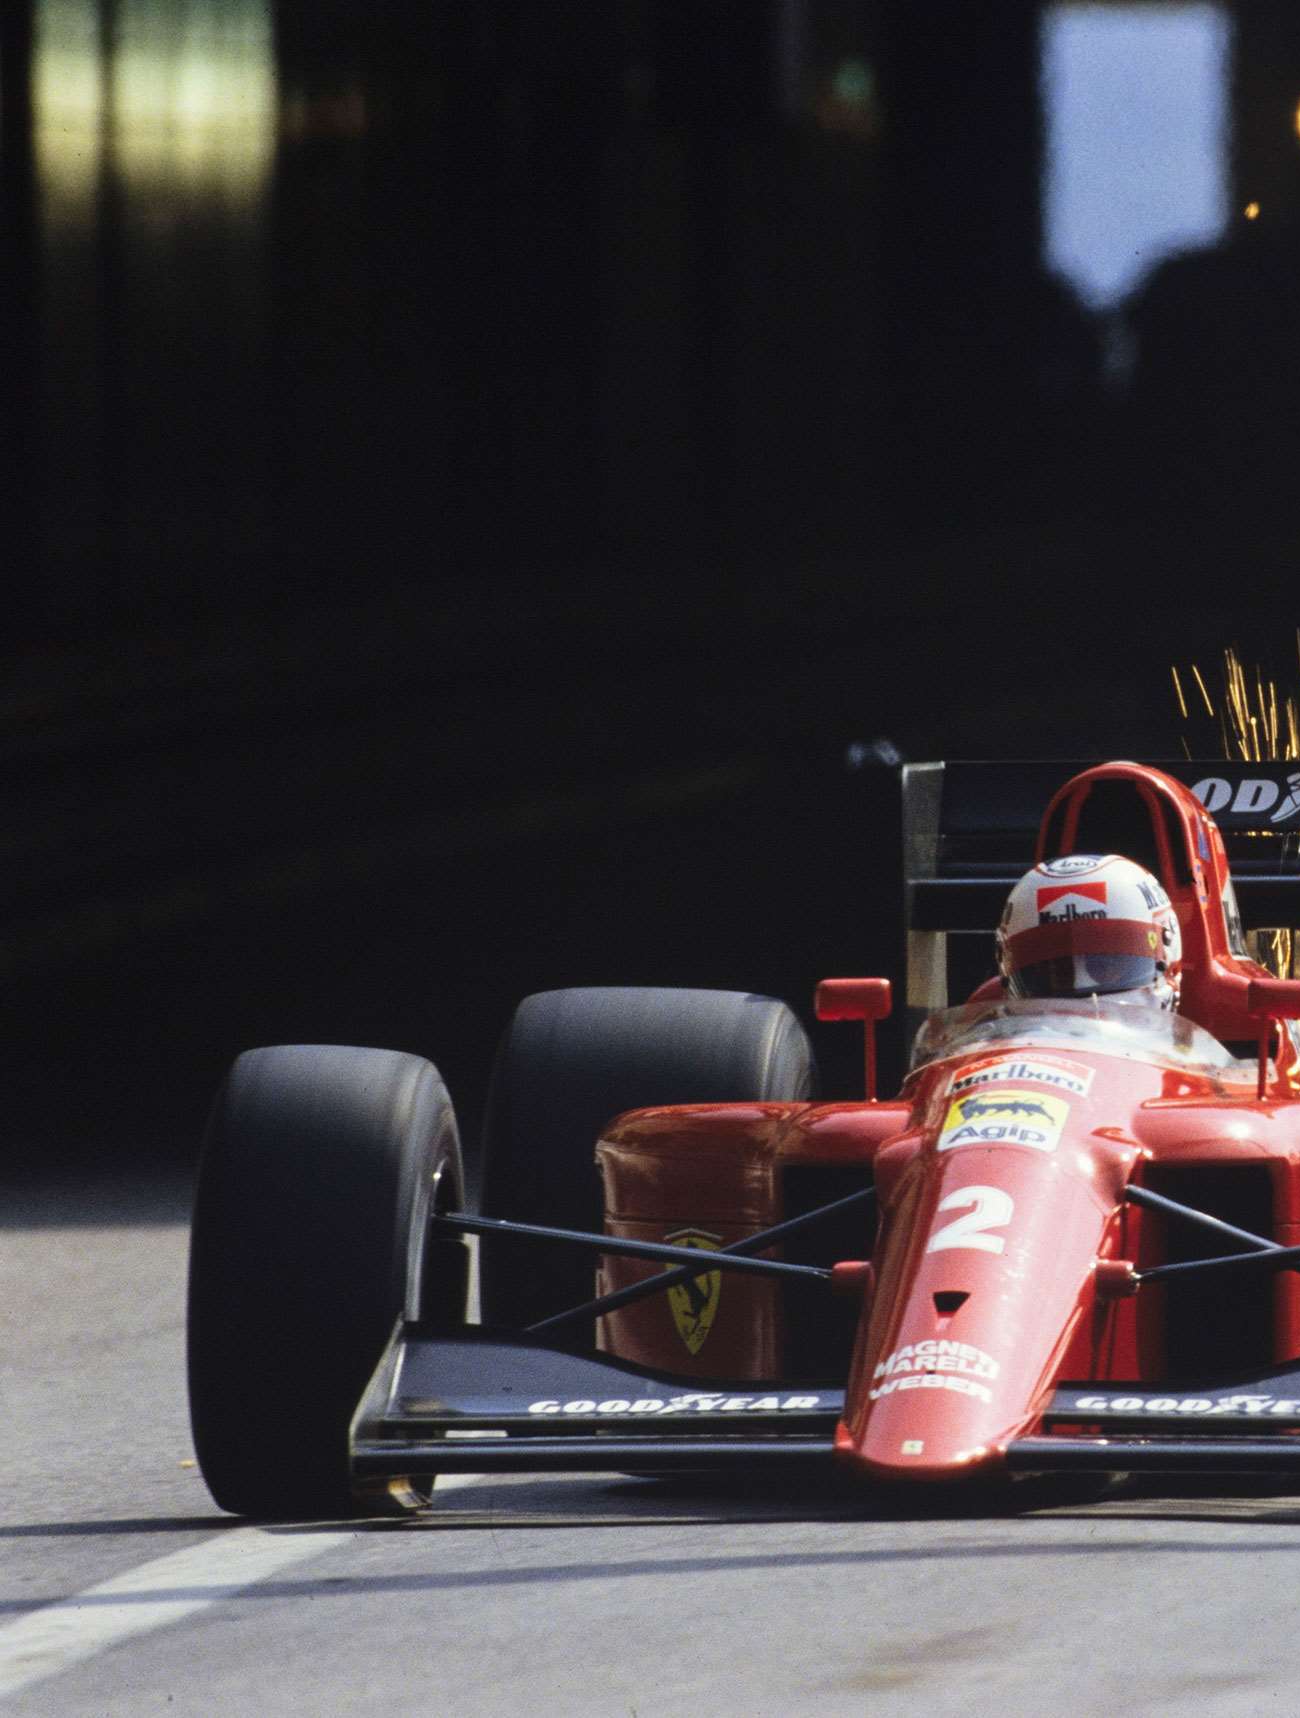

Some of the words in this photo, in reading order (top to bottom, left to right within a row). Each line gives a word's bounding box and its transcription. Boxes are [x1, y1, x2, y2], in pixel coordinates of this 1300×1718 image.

[951, 1063, 1084, 1093] Marlboro
[947, 1124, 1047, 1145] Agip
[926, 1185, 1014, 1254] 2
[869, 1374, 993, 1403] WEBER
